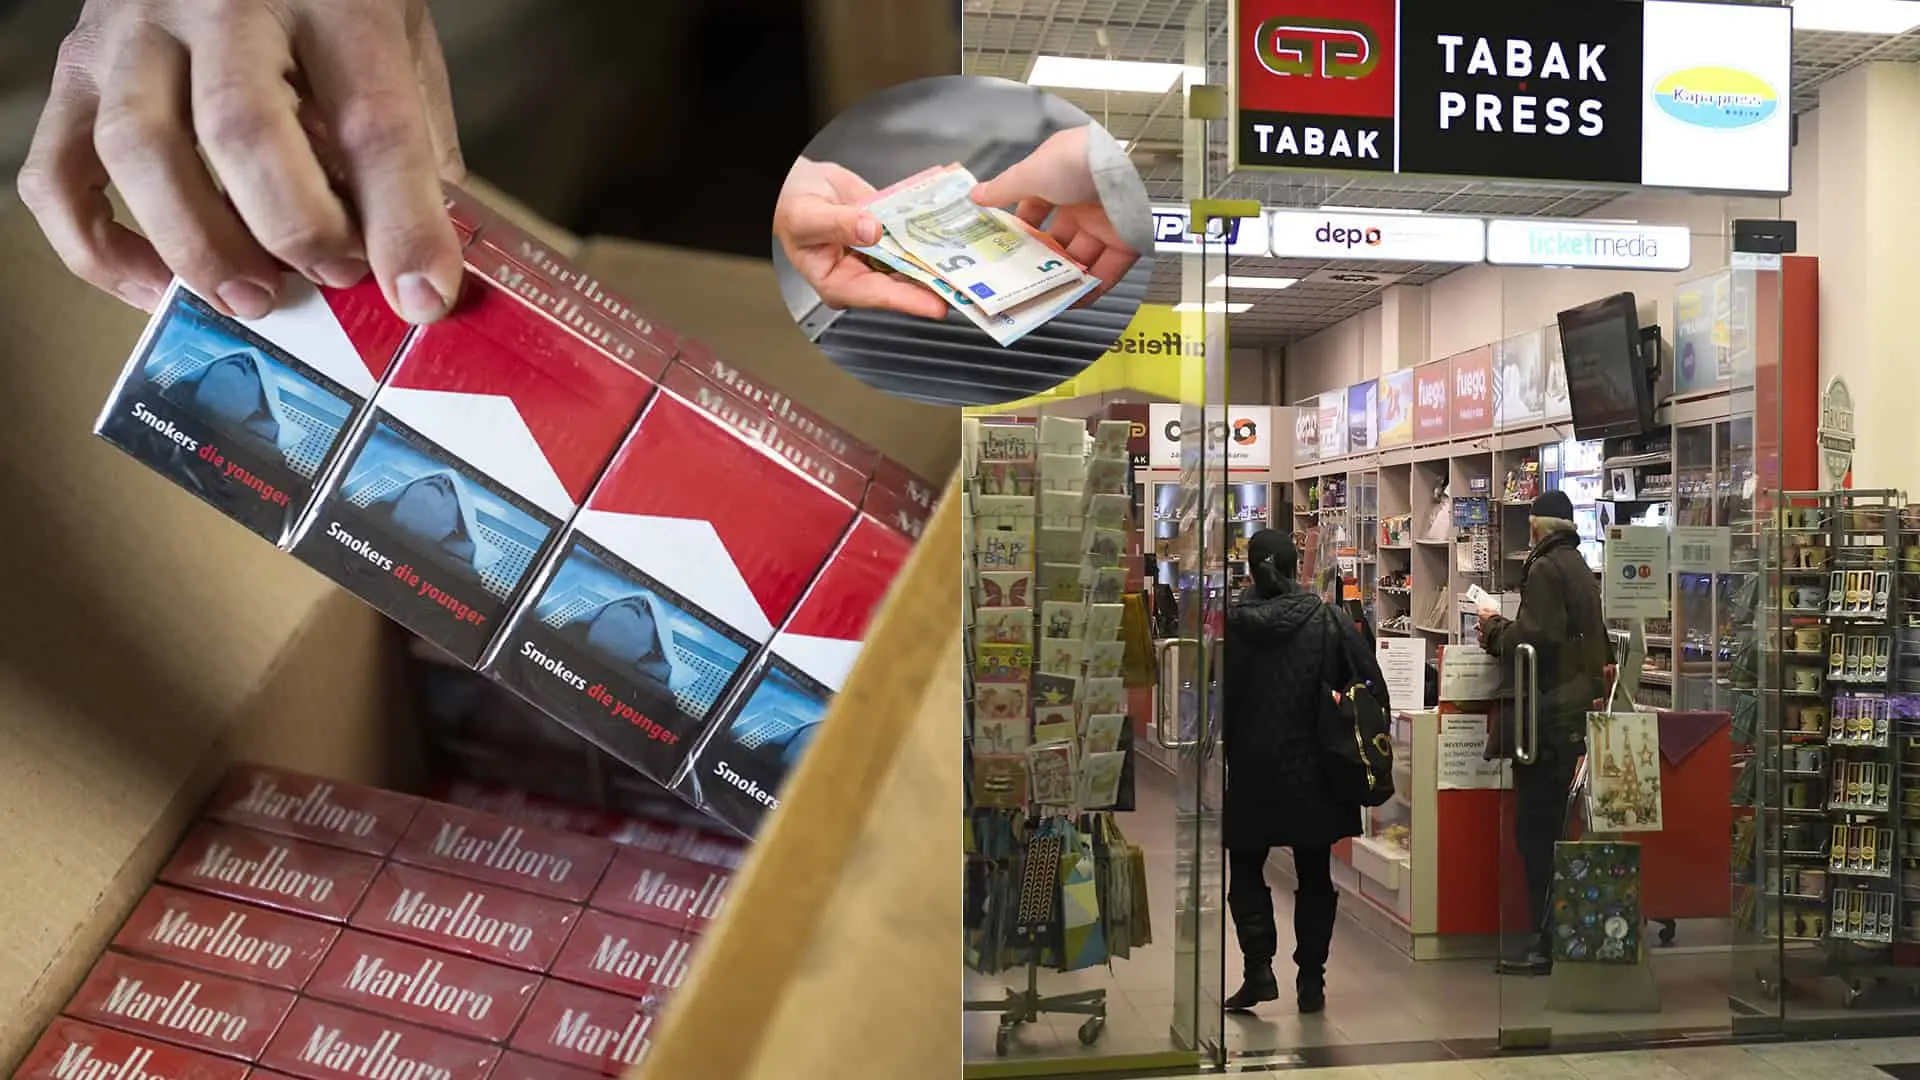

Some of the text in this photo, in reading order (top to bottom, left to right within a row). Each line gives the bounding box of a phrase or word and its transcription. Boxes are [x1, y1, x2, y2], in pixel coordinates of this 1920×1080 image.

[1437, 34, 1608, 82] TABAK
[1253, 124, 1381, 160] TABAK
[1439, 91, 1606, 137] PRESS
[1314, 221, 1382, 248] depo
[1528, 227, 1659, 260] ticketmedia
[493, 263, 637, 363] Marlboro
[518, 239, 655, 337] Marlboro
[692, 387, 840, 487] Marlboro
[708, 358, 850, 458] Marlboro
[130, 401, 291, 508] Smokers die younger
[325, 520, 487, 628] Smokers die younger
[519, 639, 681, 746] Smokers die younger
[246, 777, 379, 838] Marlboro
[712, 760, 781, 811] Smokers
[193, 843, 336, 903] Marlboro
[432, 821, 574, 885] Marlboro
[385, 887, 534, 954] Marlboro
[628, 868, 729, 922] Marlb
[147, 907, 293, 970] Marlboro
[588, 934, 691, 990] Marlb
[99, 976, 249, 1043] Marlboro
[341, 953, 494, 1022] Marlboro
[48, 1041, 168, 1080] Marlb
[297, 1023, 454, 1080] Marlboro
[548, 1008, 652, 1066] Marlb
